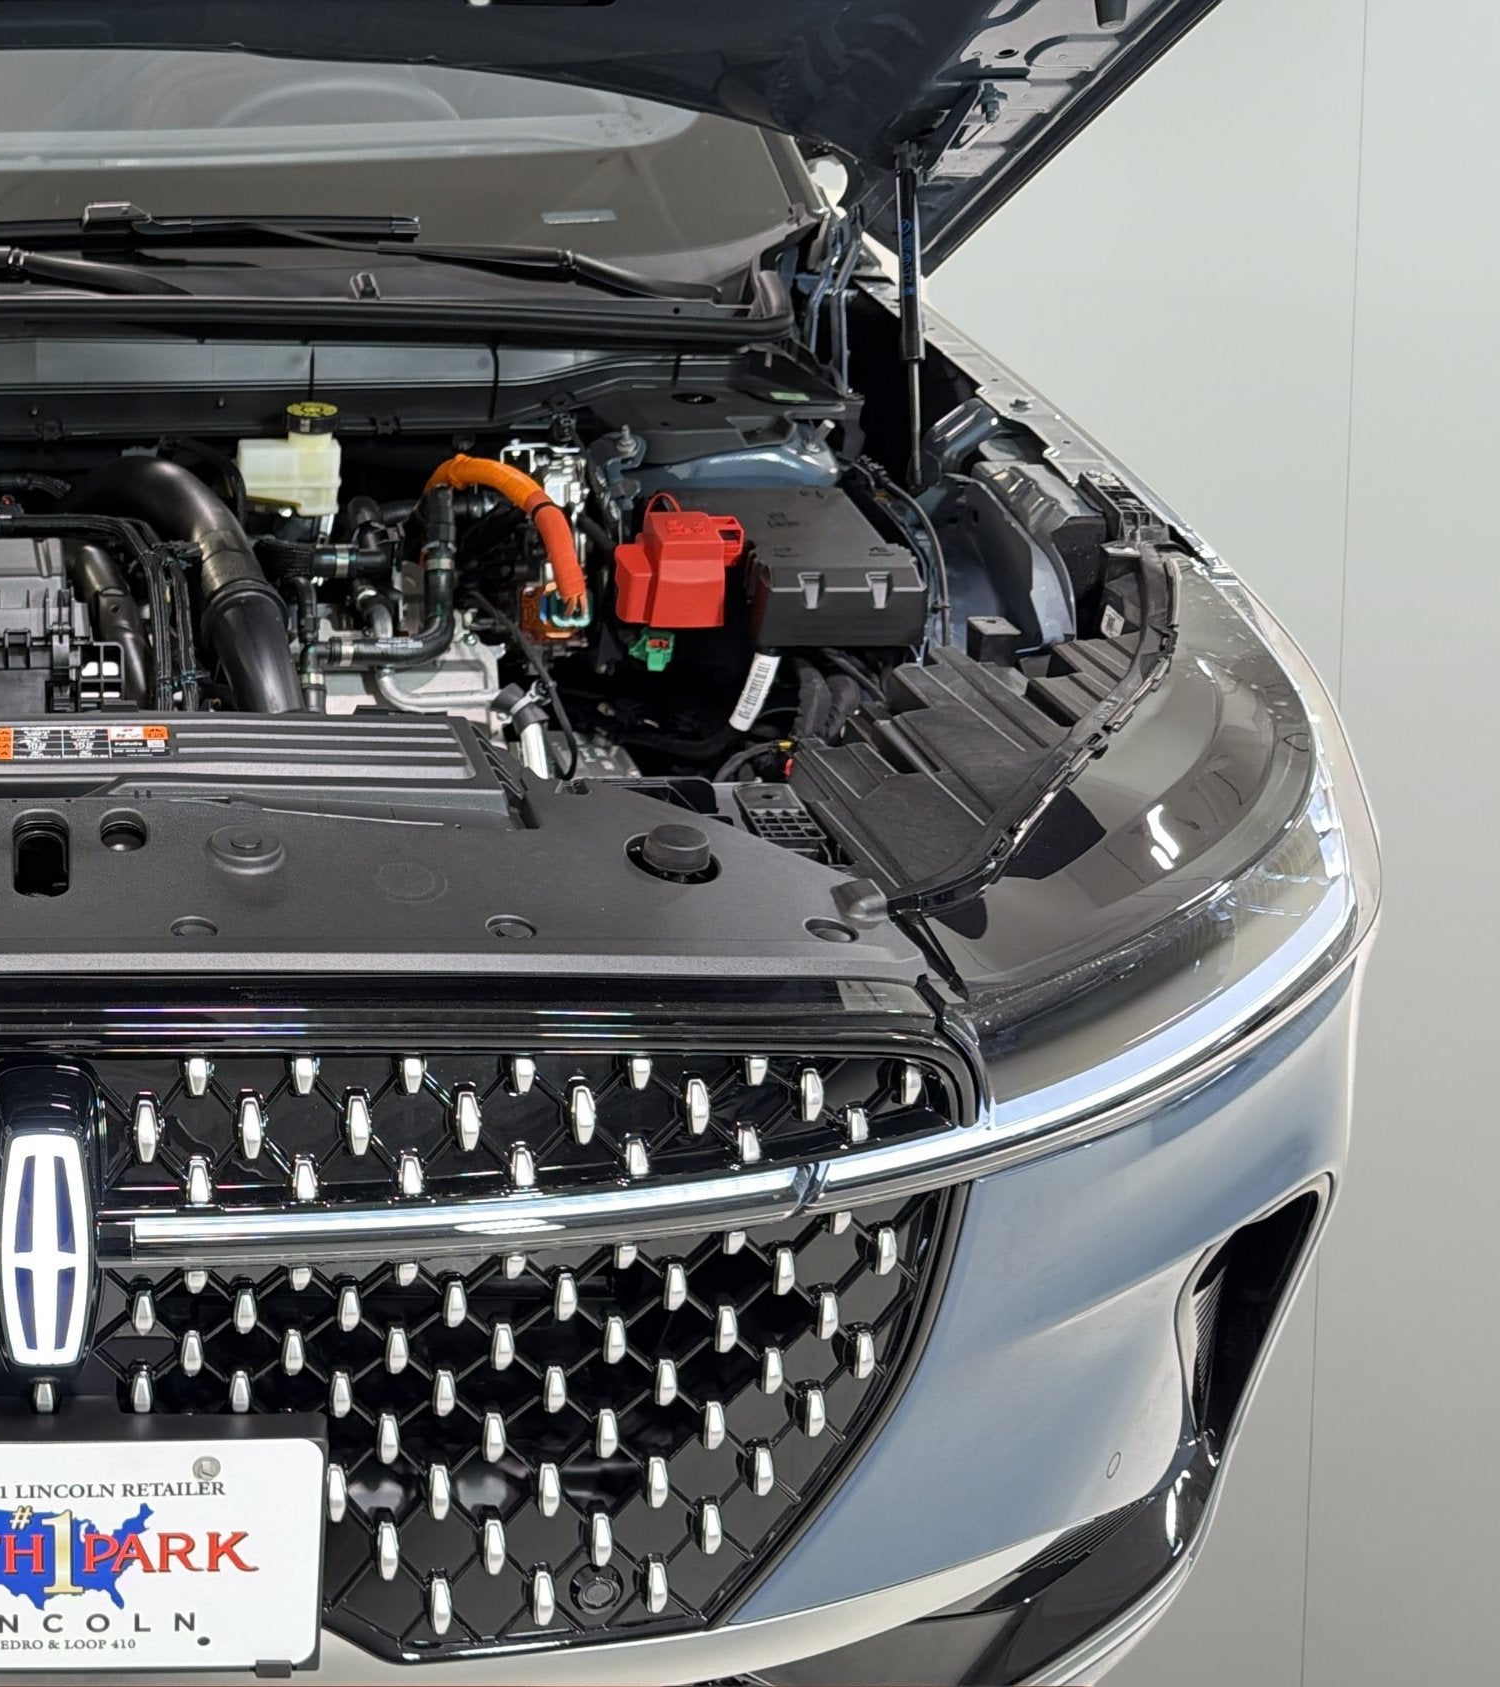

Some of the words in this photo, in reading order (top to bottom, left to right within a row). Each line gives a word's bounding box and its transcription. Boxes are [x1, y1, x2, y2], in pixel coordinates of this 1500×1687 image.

[15, 1483, 116, 1499] LINCOLN
[121, 1481, 227, 1498] RETAILER
[82, 1531, 260, 1573] PARK
[48, 1640, 60, 1650] &
[64, 1639, 108, 1650] LOOP
[110, 1638, 137, 1650] 410
